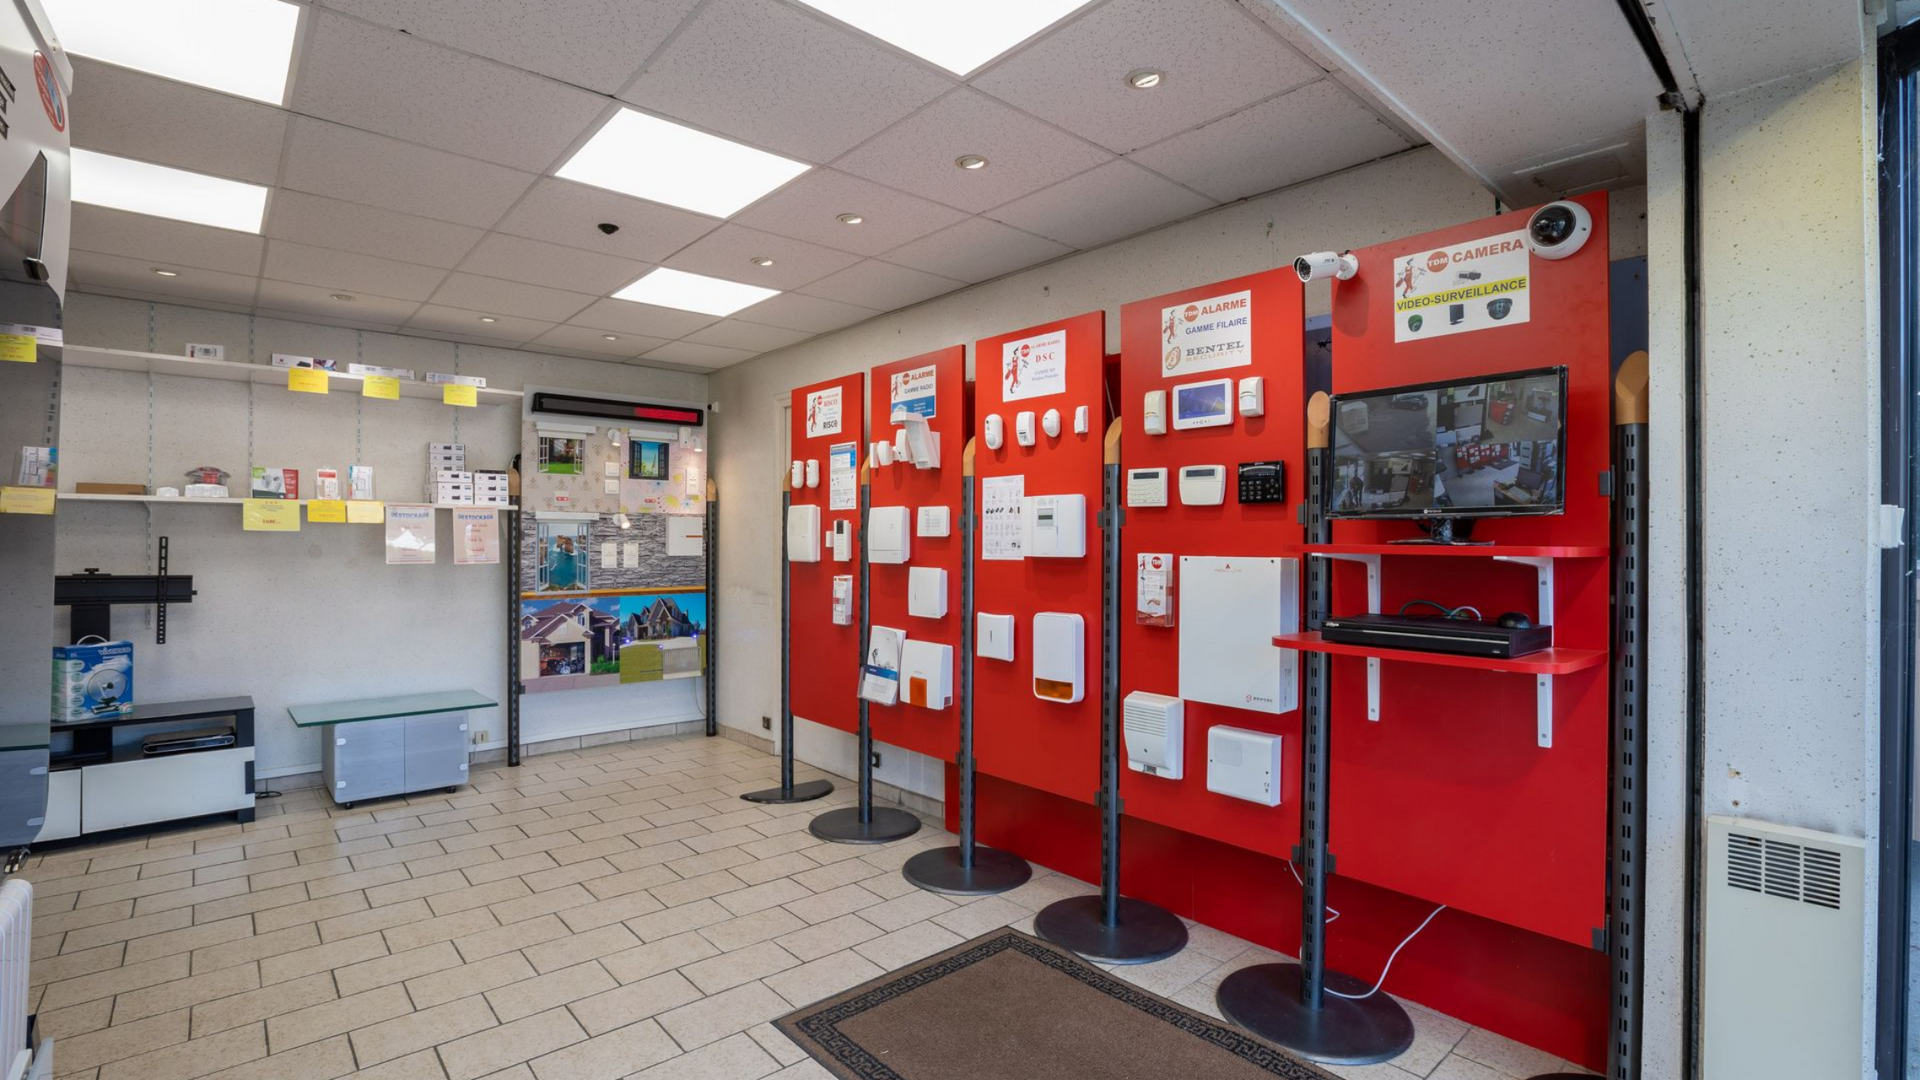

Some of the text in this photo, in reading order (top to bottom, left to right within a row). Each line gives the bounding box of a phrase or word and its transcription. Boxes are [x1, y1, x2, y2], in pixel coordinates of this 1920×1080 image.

[1427, 239, 1524, 267] TDM CAMERA
[1396, 278, 1527, 311] VIDEO-SURVEILLANCE
[1201, 298, 1247, 316] ALARME
[1185, 317, 1248, 335] GAMME FILAIRE
[1186, 341, 1245, 357] BENTEL
[911, 369, 935, 381] ALARME
[904, 383, 934, 394] GAMME RADIO
[823, 420, 838, 429] RISCO
